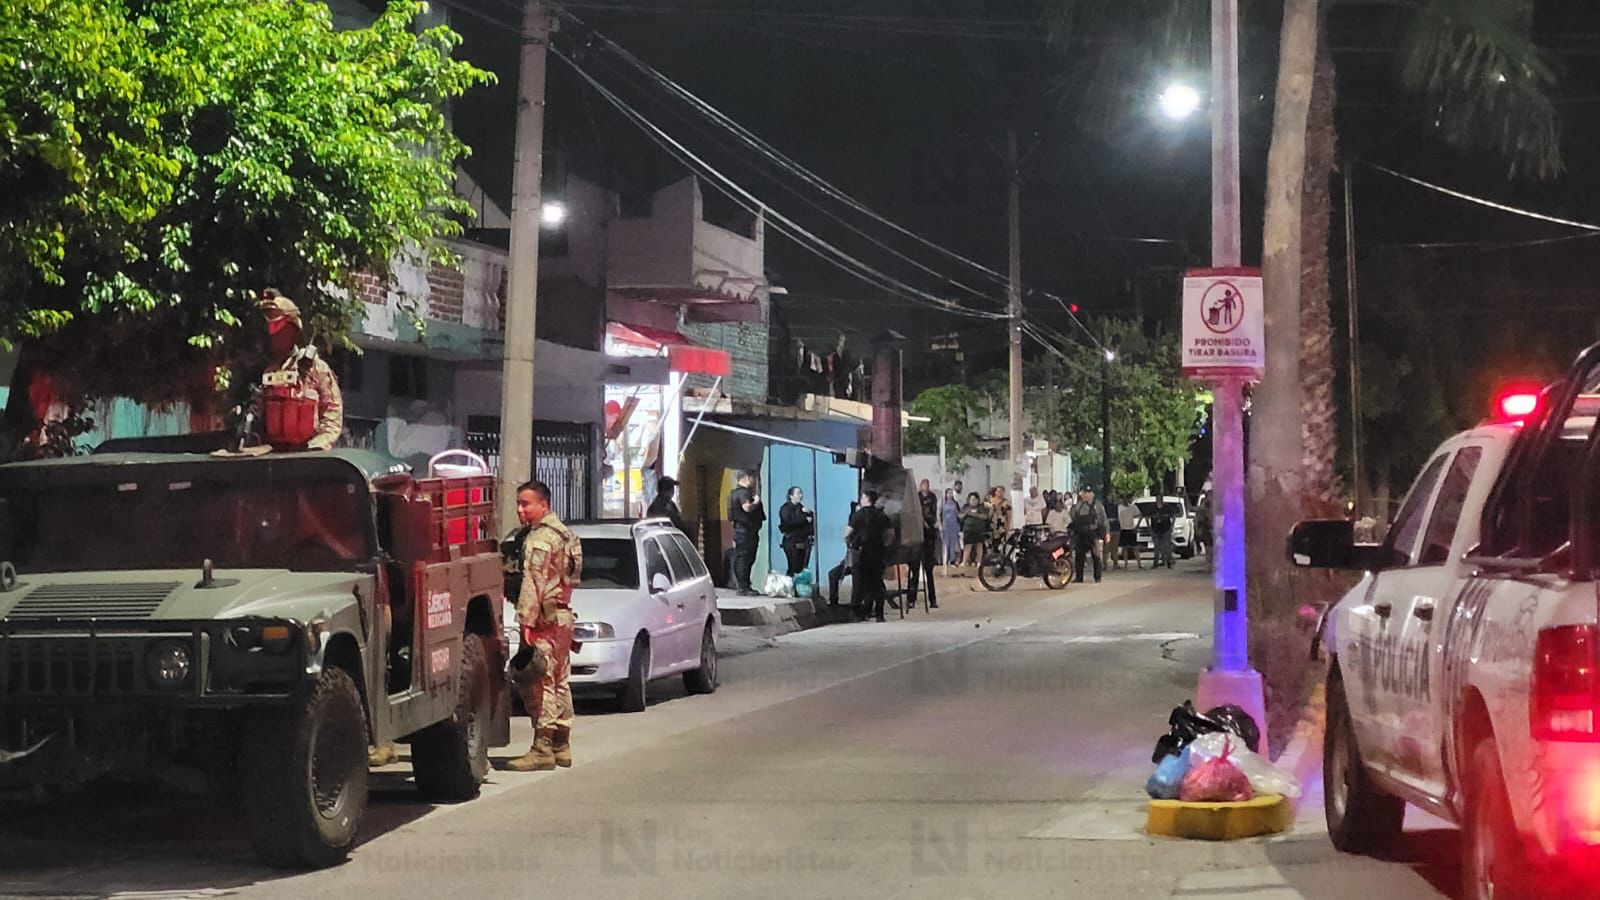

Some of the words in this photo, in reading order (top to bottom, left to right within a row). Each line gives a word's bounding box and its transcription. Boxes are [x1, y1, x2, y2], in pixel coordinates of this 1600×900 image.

[1195, 338, 1251, 346] PROHIBIDO
[1188, 349, 1214, 357] TIRAR
[1217, 348, 1257, 357] BASURA
